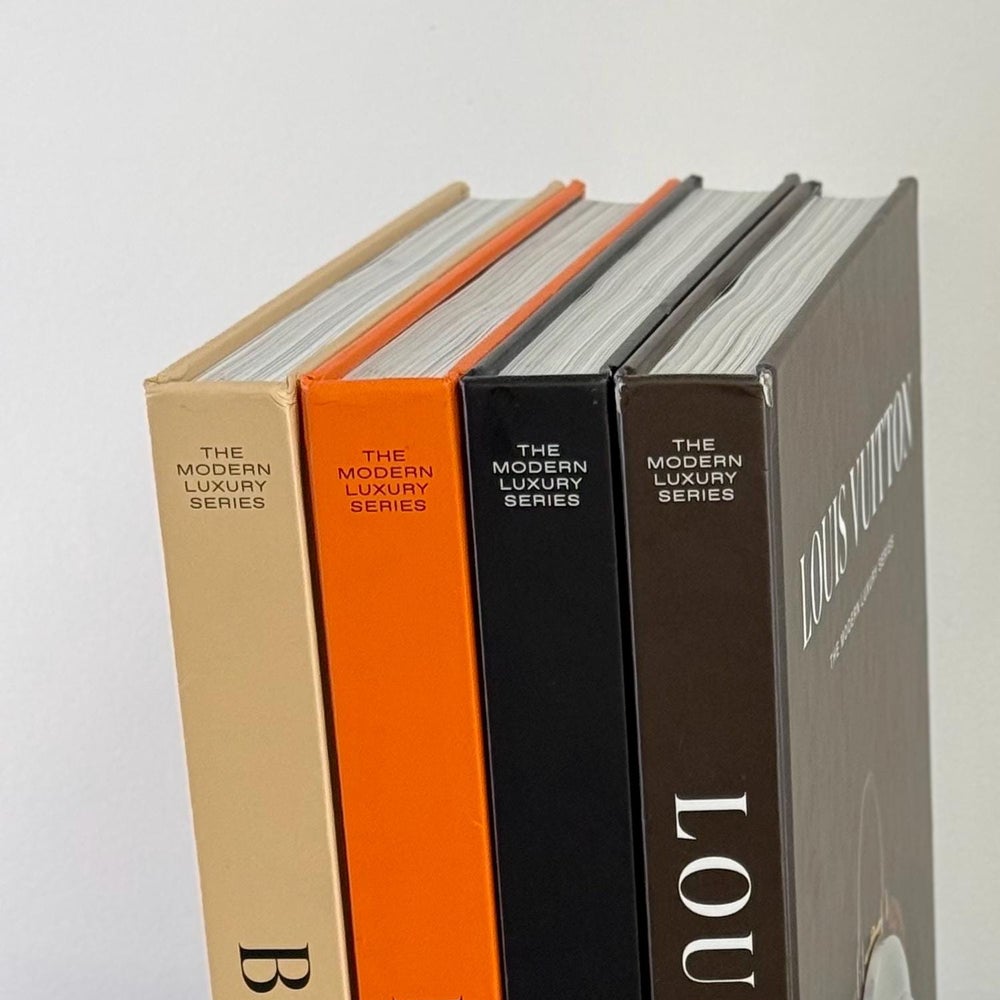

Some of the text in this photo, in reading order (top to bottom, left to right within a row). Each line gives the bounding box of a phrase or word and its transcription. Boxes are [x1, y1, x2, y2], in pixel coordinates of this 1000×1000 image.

[517, 444, 560, 456] THE
[672, 439, 715, 451] THE
[200, 447, 243, 458] THE
[363, 450, 405, 462] THE
[493, 461, 586, 473] MODERN
[648, 455, 741, 469] MODERN
[177, 464, 270, 475] MODERN
[338, 466, 432, 479] MODERN
[500, 478, 582, 490] LUXURY
[655, 472, 736, 485] LUXURY
[185, 480, 266, 492] LUXURY
[345, 482, 428, 497] LUXURY
[505, 494, 579, 506] SERIES
[659, 489, 734, 502] SERIES
[191, 497, 264, 509] SERIES
[350, 499, 426, 512] SERIES
[800, 484, 848, 650] LOUIS
